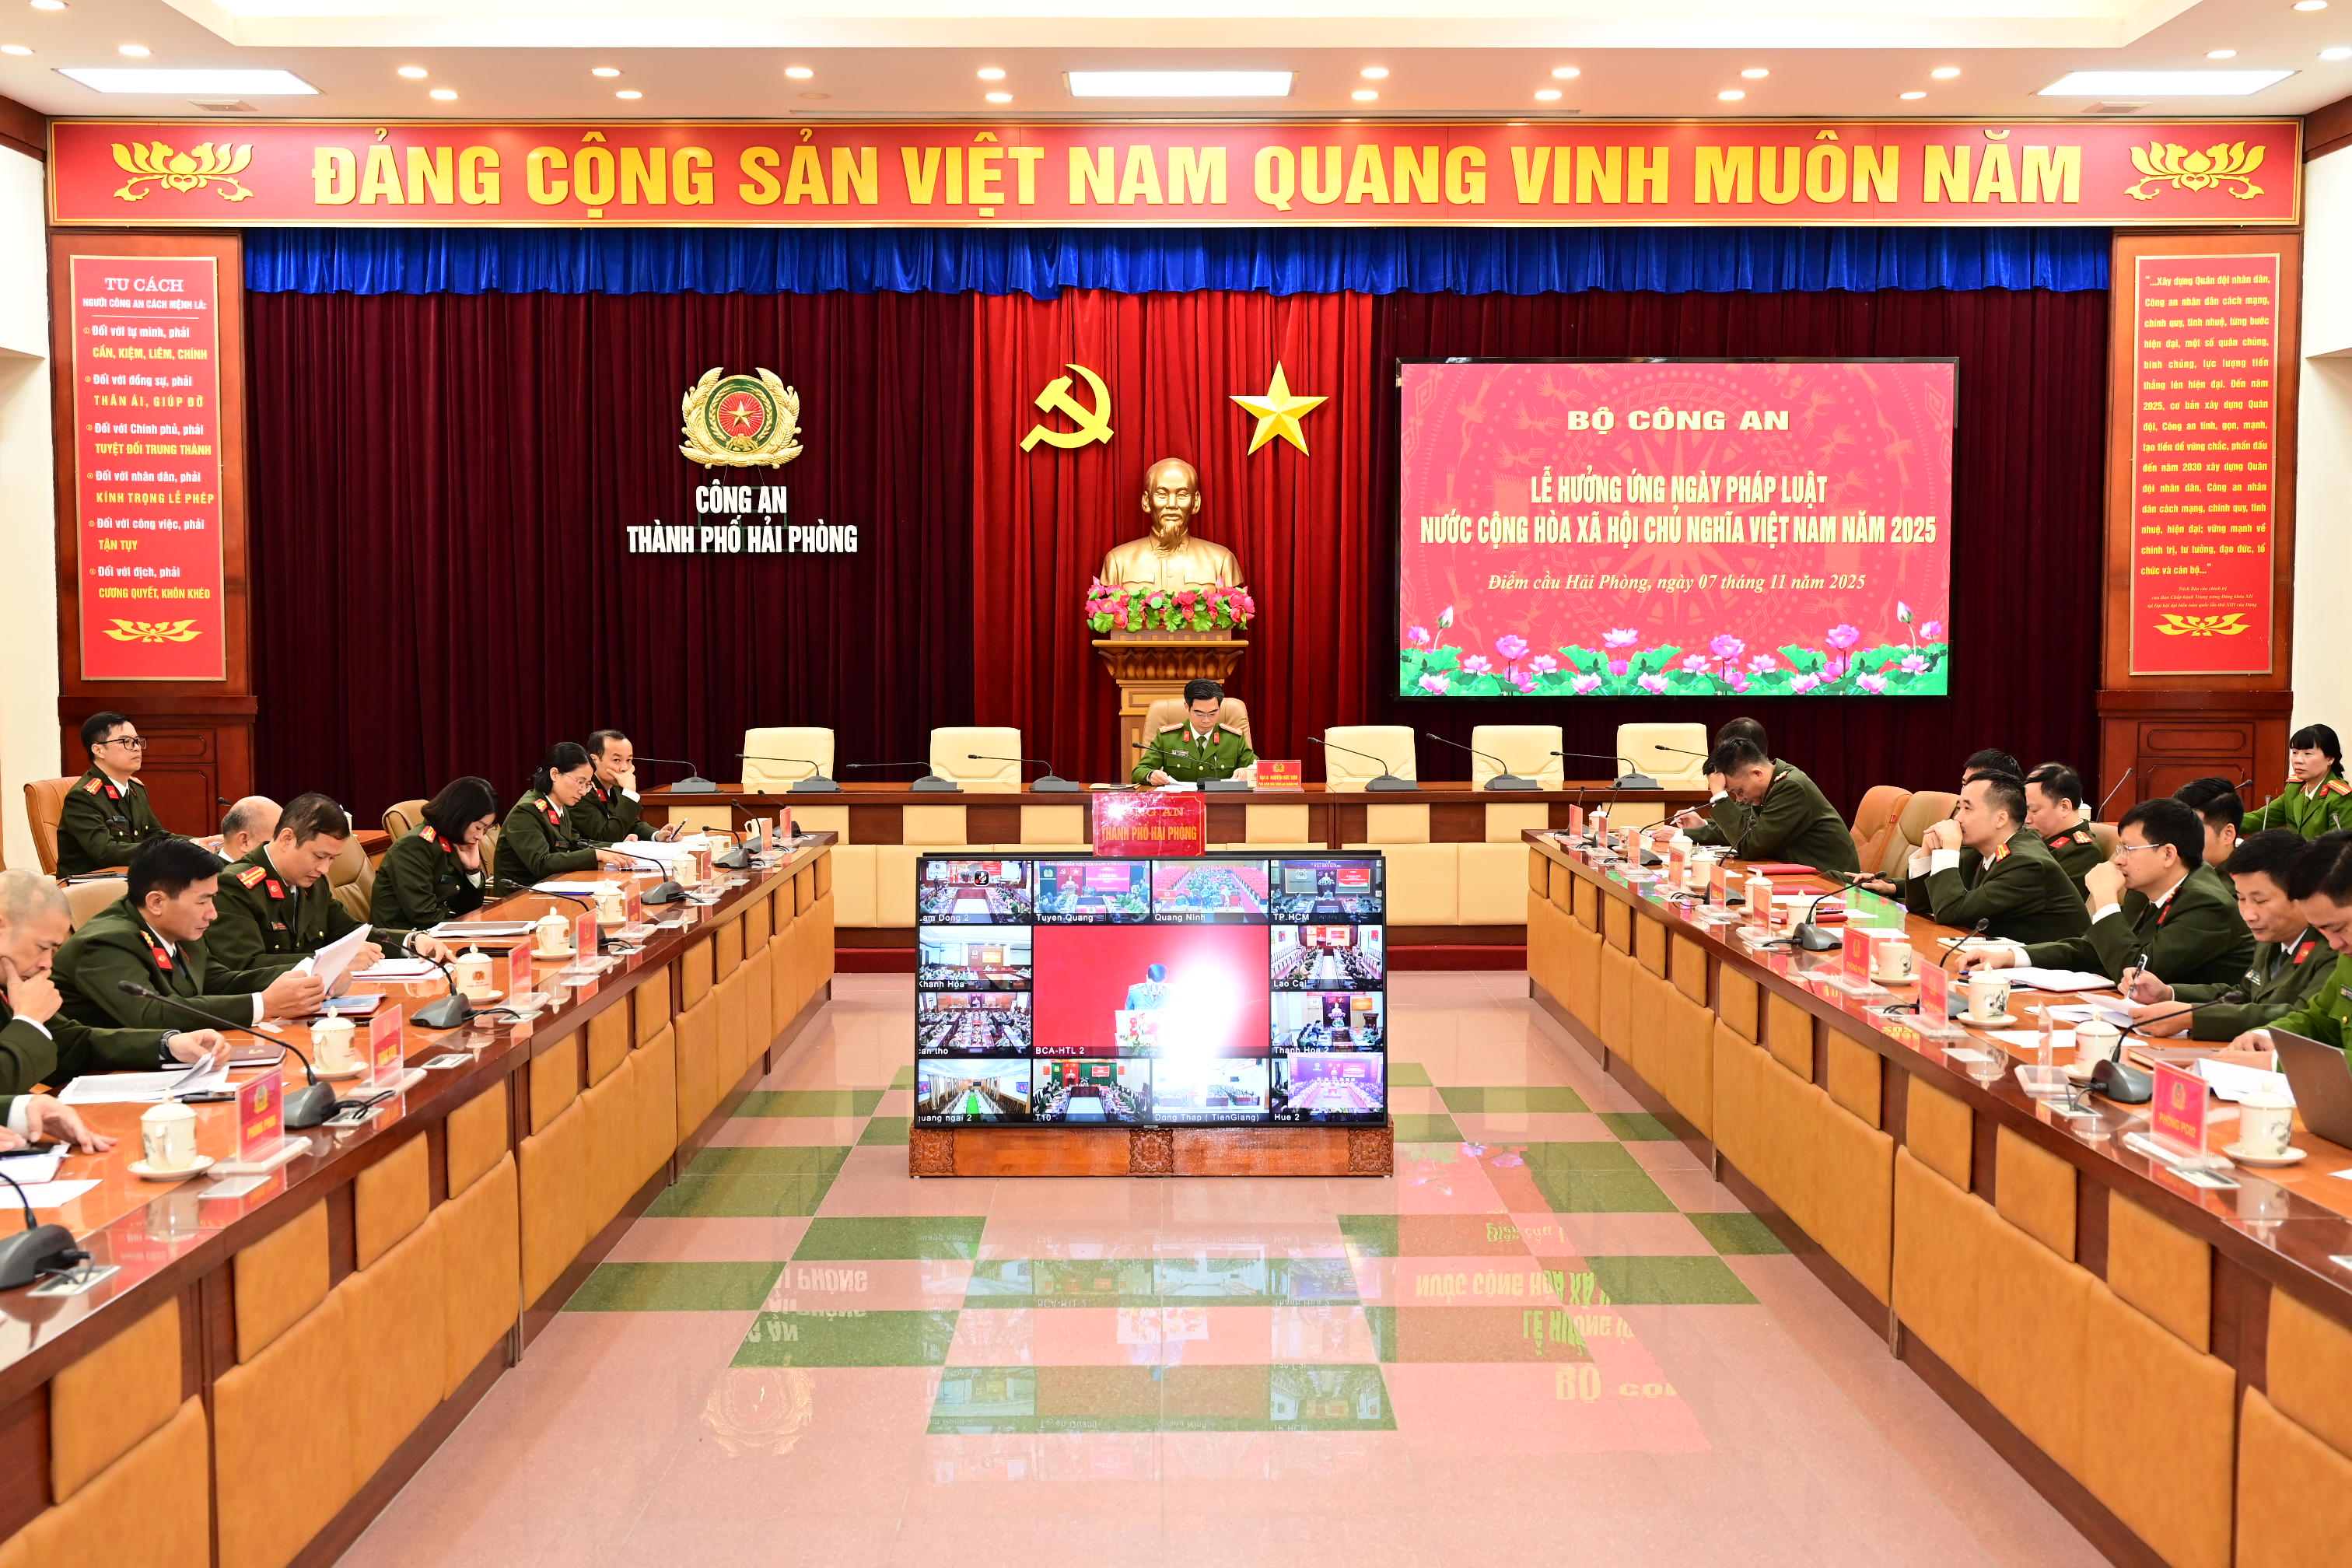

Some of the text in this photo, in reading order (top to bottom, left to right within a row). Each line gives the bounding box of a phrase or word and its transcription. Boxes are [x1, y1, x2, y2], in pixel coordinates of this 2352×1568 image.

[312, 128, 2081, 218] ĐẢNG CỘNG SẢN VIỆT NAM QUANG VINH MUÔN NĂM
[134, 276, 184, 292] CÁCH
[2174, 277, 2193, 287] dựng
[2195, 276, 2215, 285] Quân
[2217, 275, 2229, 285] đội
[2232, 275, 2251, 284] nhân
[82, 297, 107, 306] NGƯỜI
[109, 297, 131, 308] CÔNG
[133, 299, 144, 308] AN
[146, 299, 167, 309] CÁCH
[2145, 299, 2165, 307] Công
[2182, 297, 2201, 306] nhân
[2204, 296, 2219, 305] dân
[2223, 296, 2242, 305] cách
[110, 326, 124, 336] với
[169, 327, 189, 338] phải
[118, 346, 146, 361] KIỆM,
[149, 347, 175, 360] LIÊM,
[177, 348, 207, 359] CHÍNH
[94, 394, 126, 406] THÂN
[131, 394, 148, 408] ÁI,
[154, 395, 182, 407] GIÚP
[2205, 401, 2218, 410] xây
[2224, 401, 2243, 411] dựng
[2249, 400, 2268, 409] Quân
[1568, 407, 1788, 434] BỘ CÔNG AN
[95, 441, 211, 456] TUYỆT ĐỐI TRUNG THÀNH
[2143, 462, 2157, 472] đến
[2182, 463, 2203, 471] 2030
[2206, 462, 2220, 471] xây
[2224, 462, 2243, 472] dựng
[2248, 462, 2267, 471] Quân
[1531, 465, 1827, 509] LỄ HƯỞNG ỨNG NGÀY PHÁP LUẬT
[96, 490, 214, 506] KÍNH TRỌNG LỄ PHÉP
[696, 479, 786, 513] CÔNG AN
[627, 515, 857, 552] THÀNH PHỐ HẢI PHÒNG
[1421, 506, 1936, 549] NƯỚC CỘNG HÒA XÃ HỘI CHỦ NGHĨA VIỆT NAM NĂM 2025
[2220, 544, 2234, 555] đạo
[1489, 571, 1866, 593] Điểm cầu Hải Phòng, ngày 07 tháng 11 năm 2025
[99, 586, 210, 599] CƯƠNG QUYẾT, KHÔN KHÉO
[1162, 807, 1185, 817] AN
[1132, 822, 1149, 840] PHỐ
[1168, 823, 1197, 840] PHÒNG
[1036, 914, 1094, 923] Tuyen Quang
[1154, 913, 1183, 922] Quang
[1035, 1046, 1085, 1055] BCA-HTL 2
[945, 1114, 964, 1122] ngai
[1155, 1113, 1179, 1122] Dong
[1181, 1113, 1202, 1122] Thap
[1212, 1113, 1259, 1122] TienGiang)
[1274, 1113, 1300, 1122] Hue 2
[2159, 1113, 2180, 1130] PHÒNG
